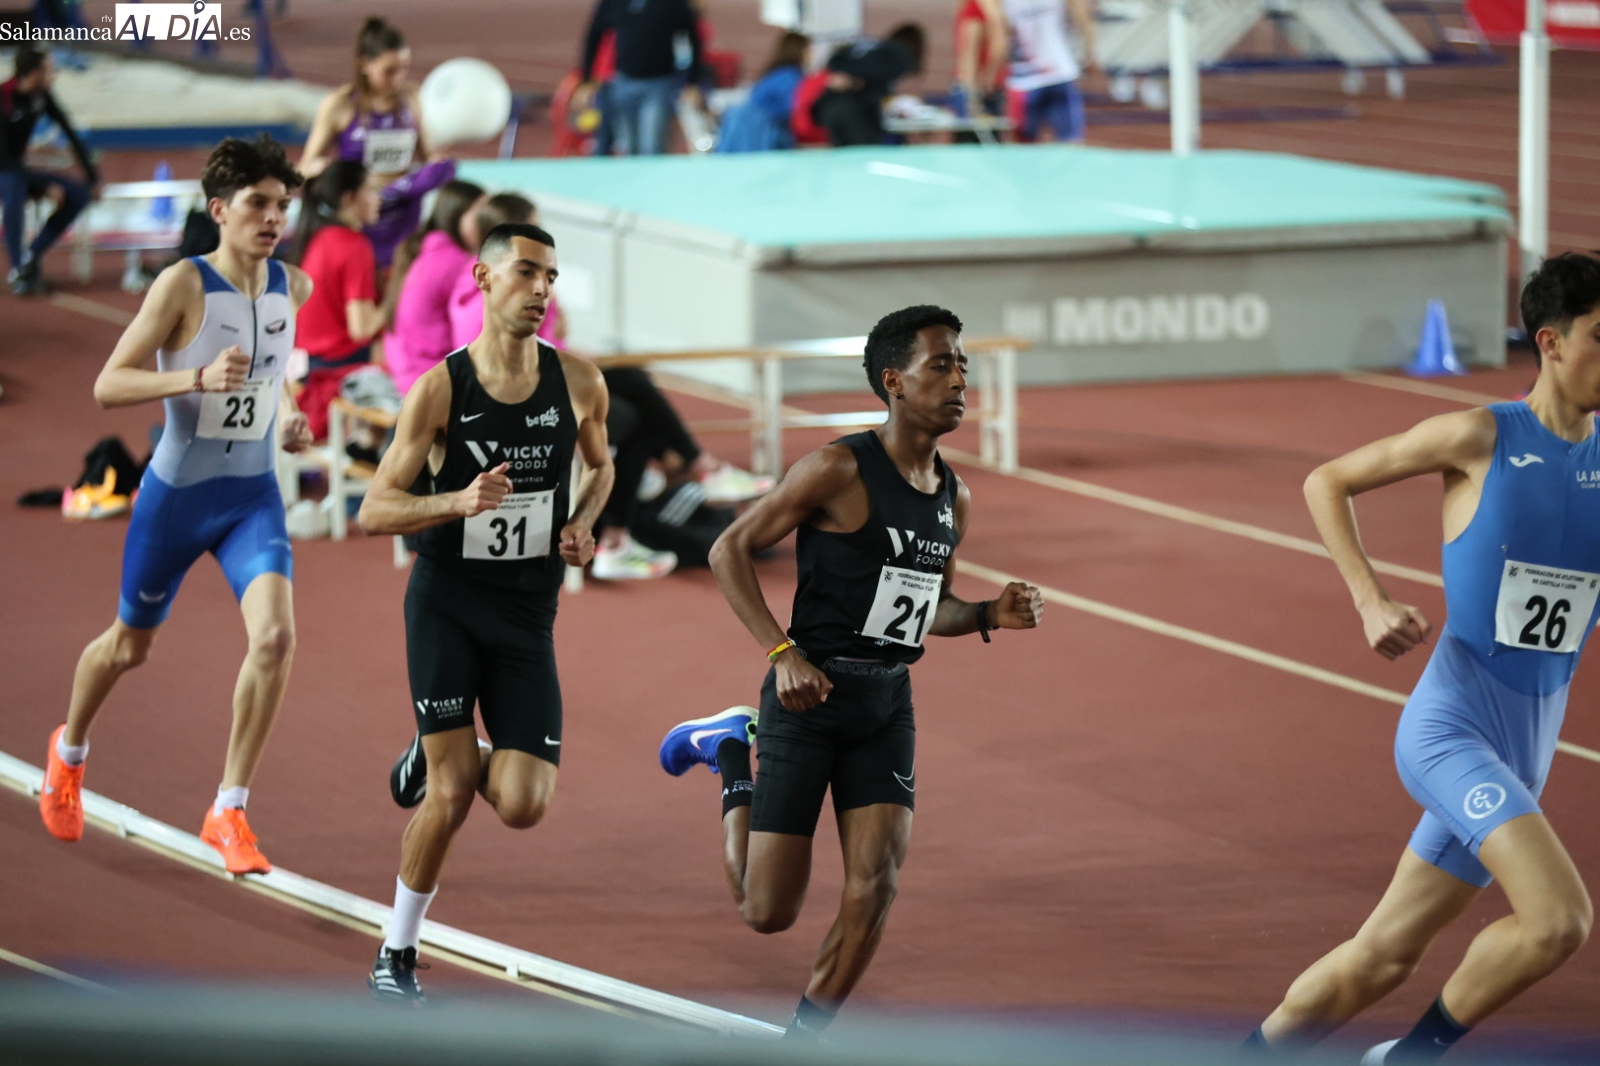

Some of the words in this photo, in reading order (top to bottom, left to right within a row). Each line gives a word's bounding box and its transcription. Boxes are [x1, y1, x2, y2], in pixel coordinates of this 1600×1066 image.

[1053, 294, 1270, 344] MONDO
[222, 396, 256, 428] 23
[503, 444, 553, 459] VICKY
[1576, 470, 1587, 482] LA
[488, 516, 527, 557] 31
[917, 538, 951, 557] VICKY
[883, 595, 930, 644] 21
[1518, 594, 1571, 649] 26
[822, 659, 869, 675] NIKE
[432, 696, 464, 708] VICKY
